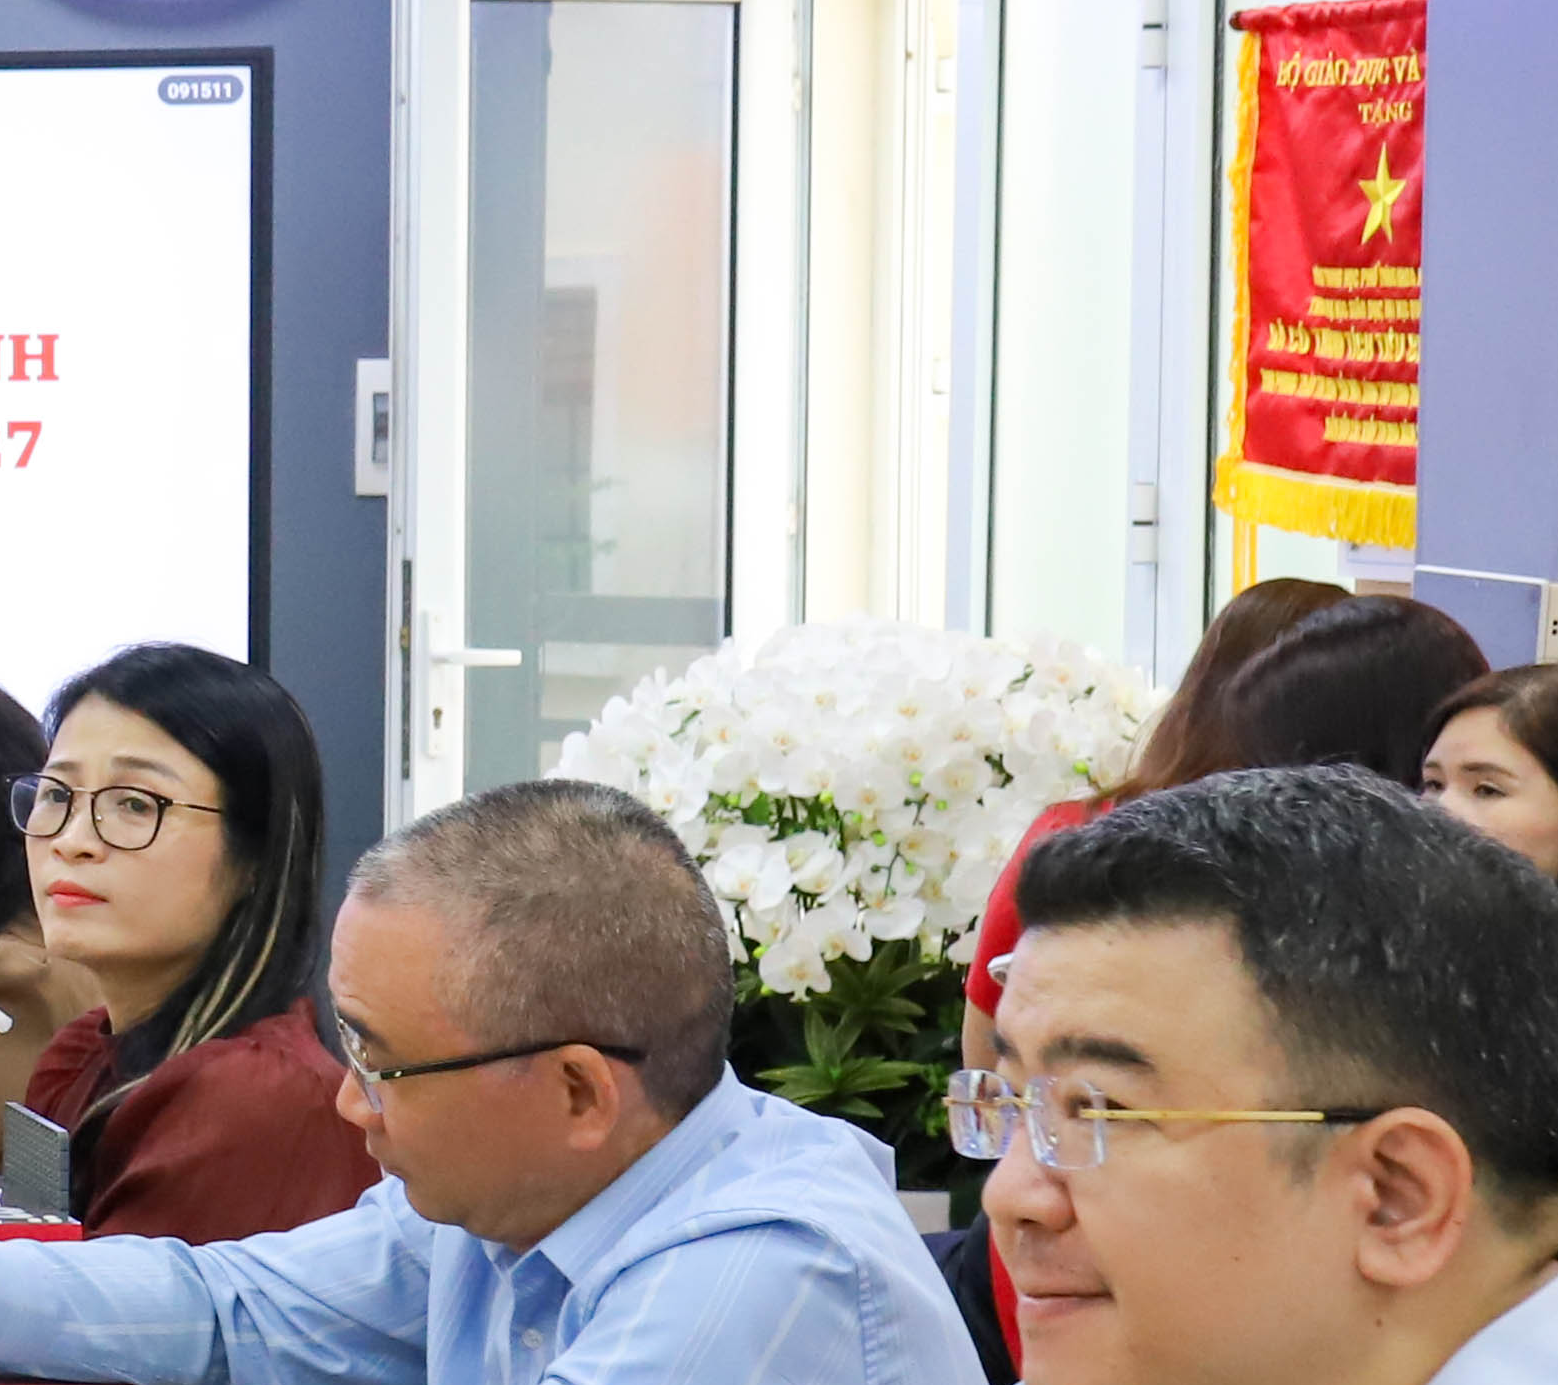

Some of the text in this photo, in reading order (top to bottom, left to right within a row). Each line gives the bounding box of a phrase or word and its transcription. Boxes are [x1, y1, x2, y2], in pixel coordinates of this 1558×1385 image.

[1304, 51, 1349, 88] GIÁO
[1350, 57, 1390, 93] DỤC
[1392, 46, 1422, 83] VÀ
[167, 82, 232, 99] 091511
[1358, 98, 1413, 128] TẶNG
